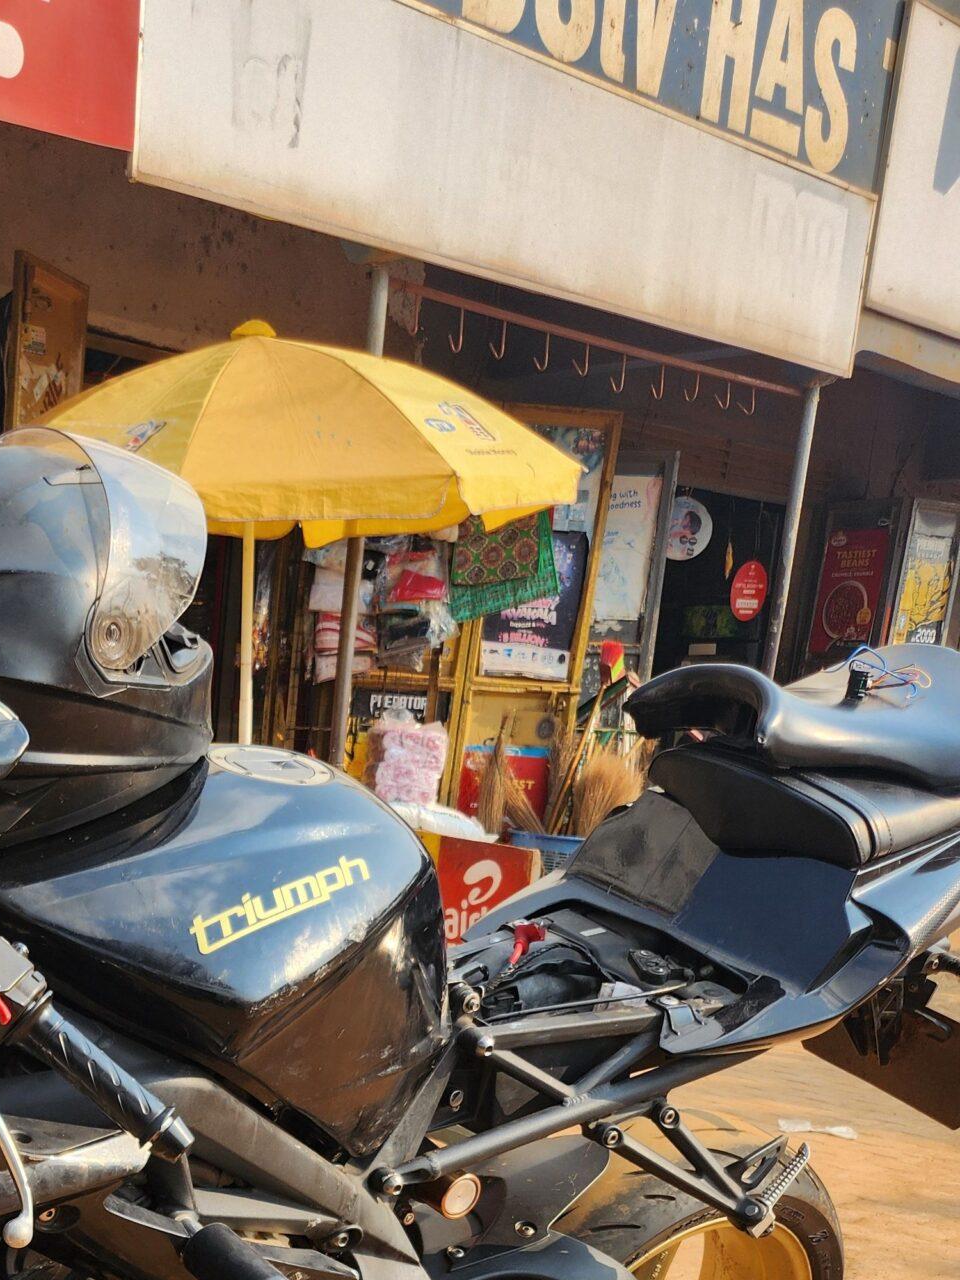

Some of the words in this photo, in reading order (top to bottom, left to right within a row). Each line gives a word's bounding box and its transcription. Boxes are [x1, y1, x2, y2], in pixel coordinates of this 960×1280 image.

[619, 489, 638, 499] with
[835, 548, 878, 560] TASTIEST
[839, 558, 870, 568] BEANS
[189, 855, 371, 955] triumph
